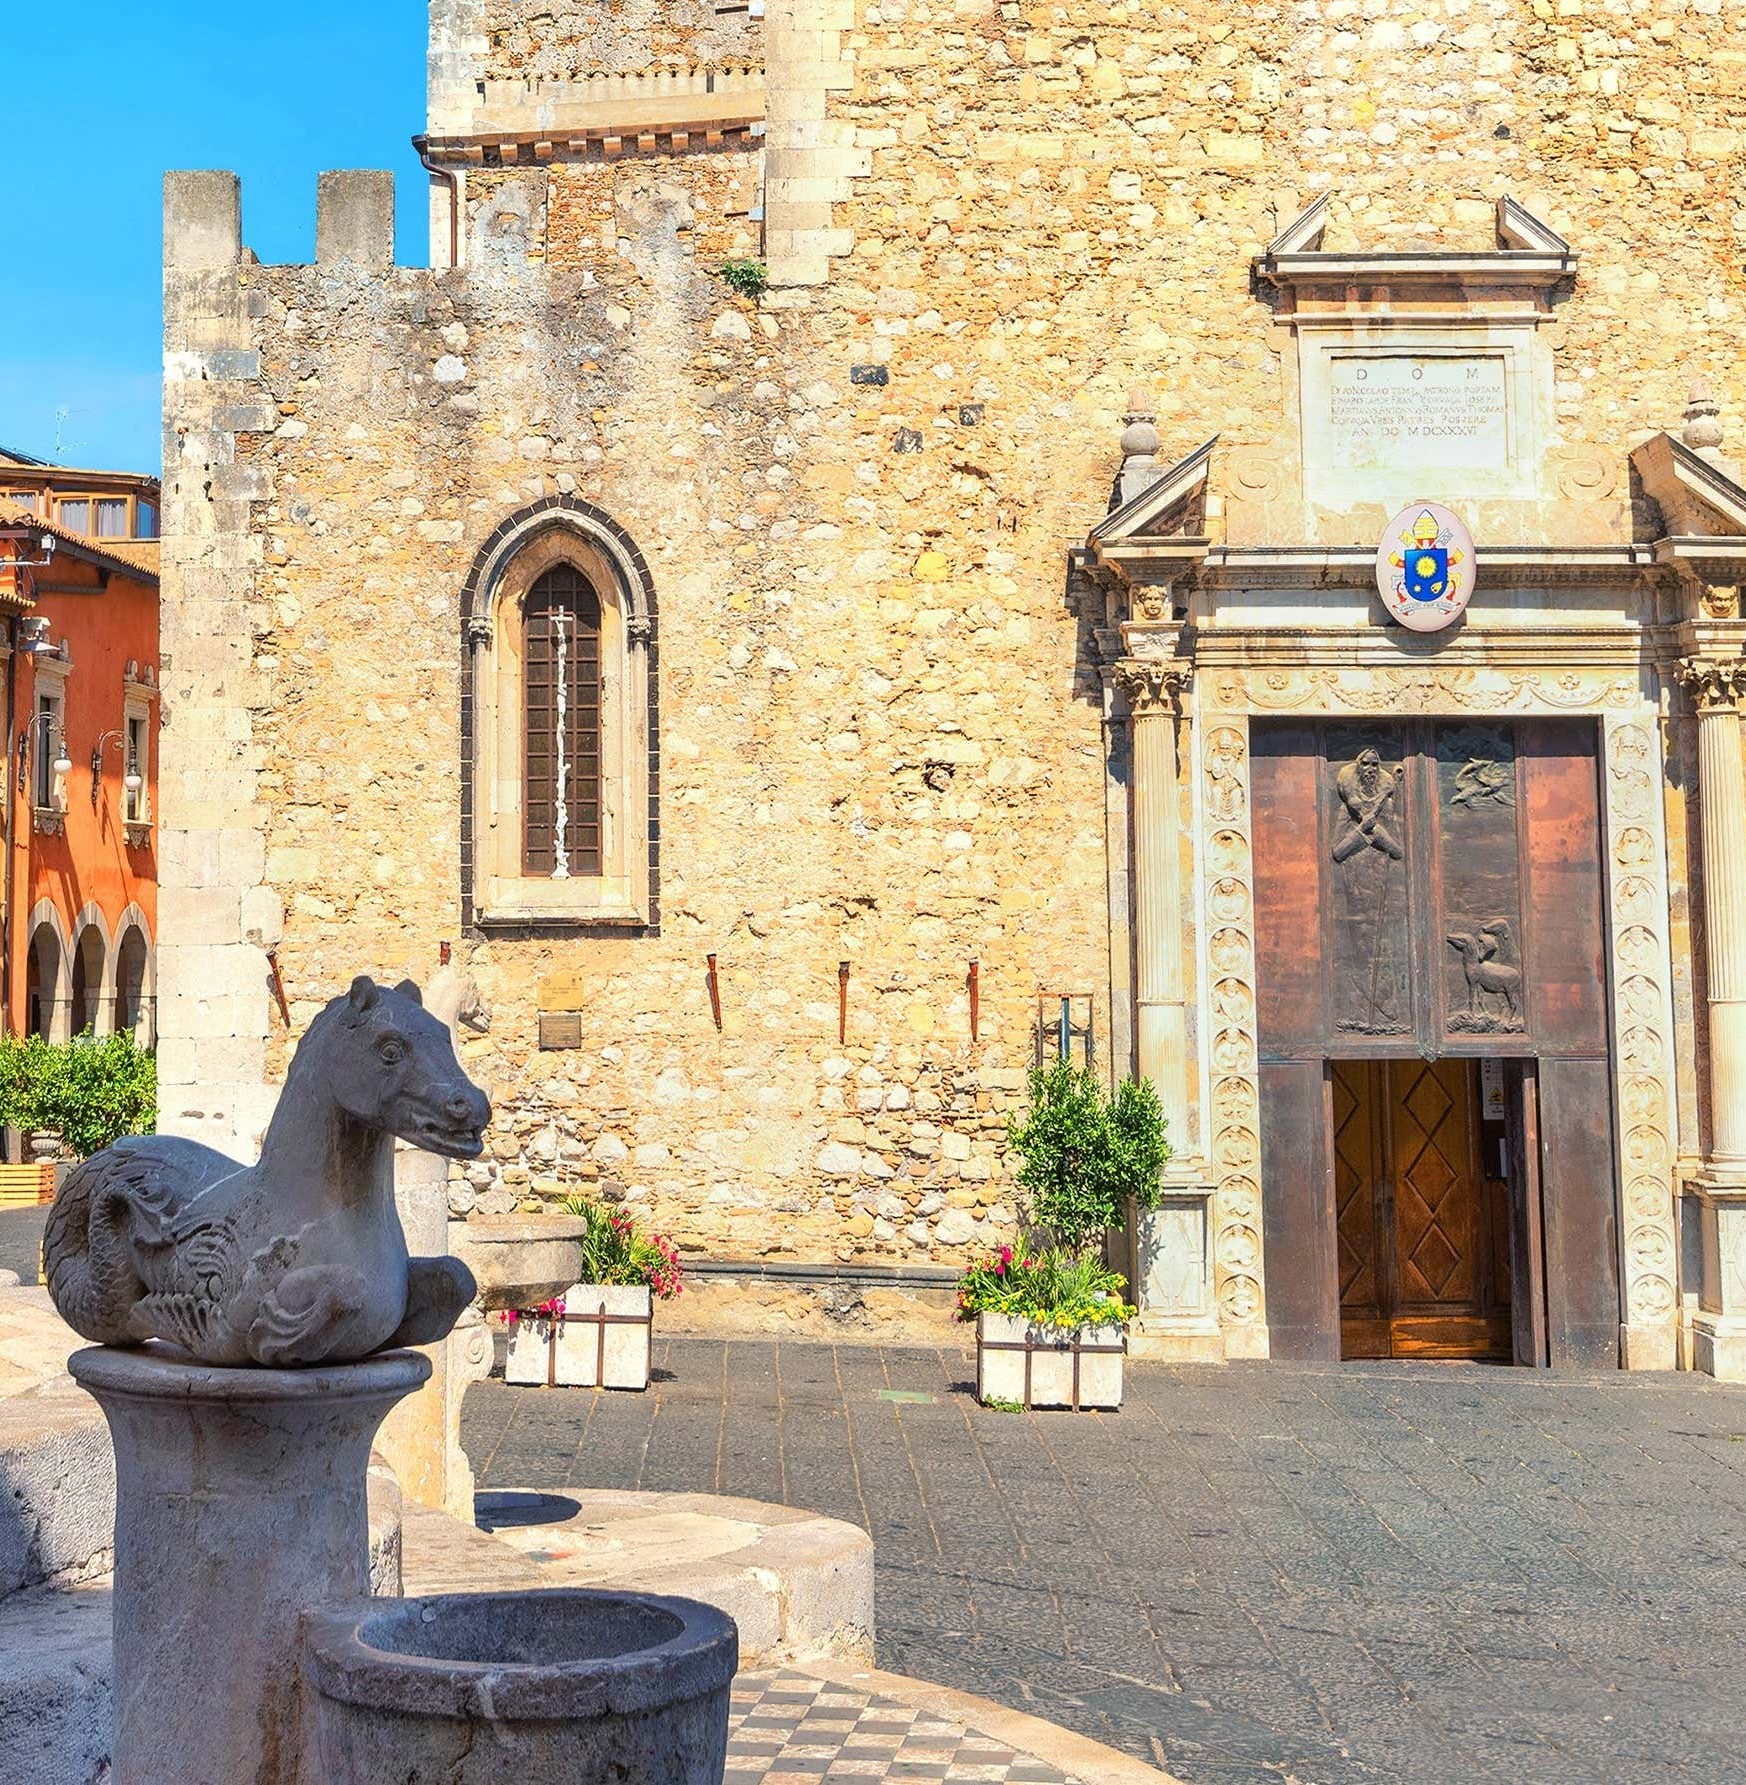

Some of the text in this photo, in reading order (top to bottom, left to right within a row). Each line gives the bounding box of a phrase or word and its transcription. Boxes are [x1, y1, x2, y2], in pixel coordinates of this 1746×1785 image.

[1357, 368, 1479, 380] D O M
